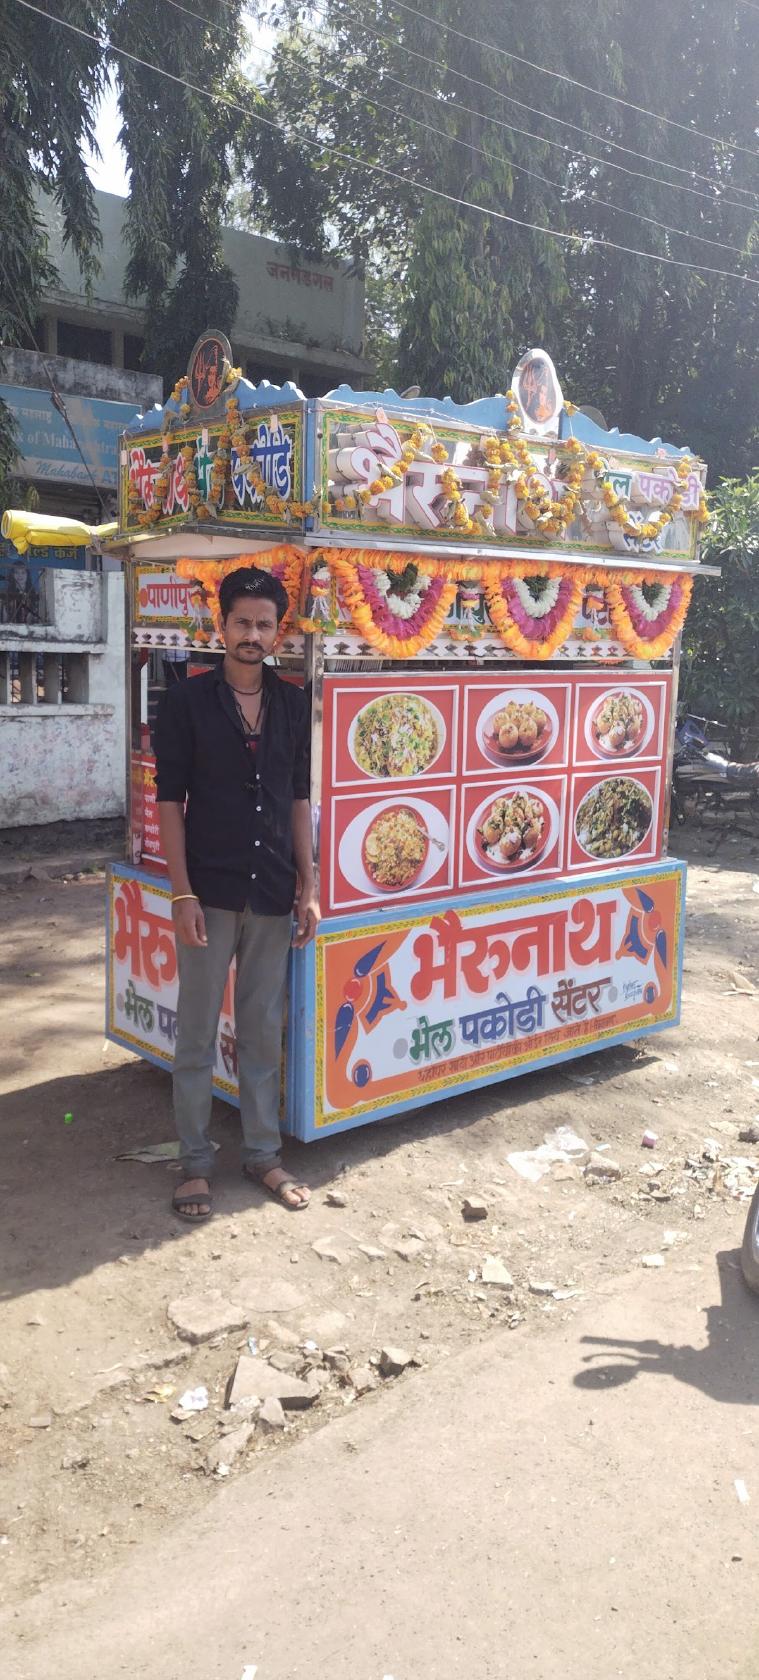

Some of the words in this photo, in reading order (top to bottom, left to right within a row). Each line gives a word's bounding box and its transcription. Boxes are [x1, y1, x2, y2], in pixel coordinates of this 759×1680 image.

[45, 433, 117, 454] Mahahtra
[114, 879, 178, 987] भैरु
[410, 898, 617, 1001] भैरुनाथ
[125, 979, 154, 1034] भेल
[409, 1015, 454, 1061] भेल
[459, 986, 547, 1044] पकोडी
[551, 977, 612, 1023] सेंटर
